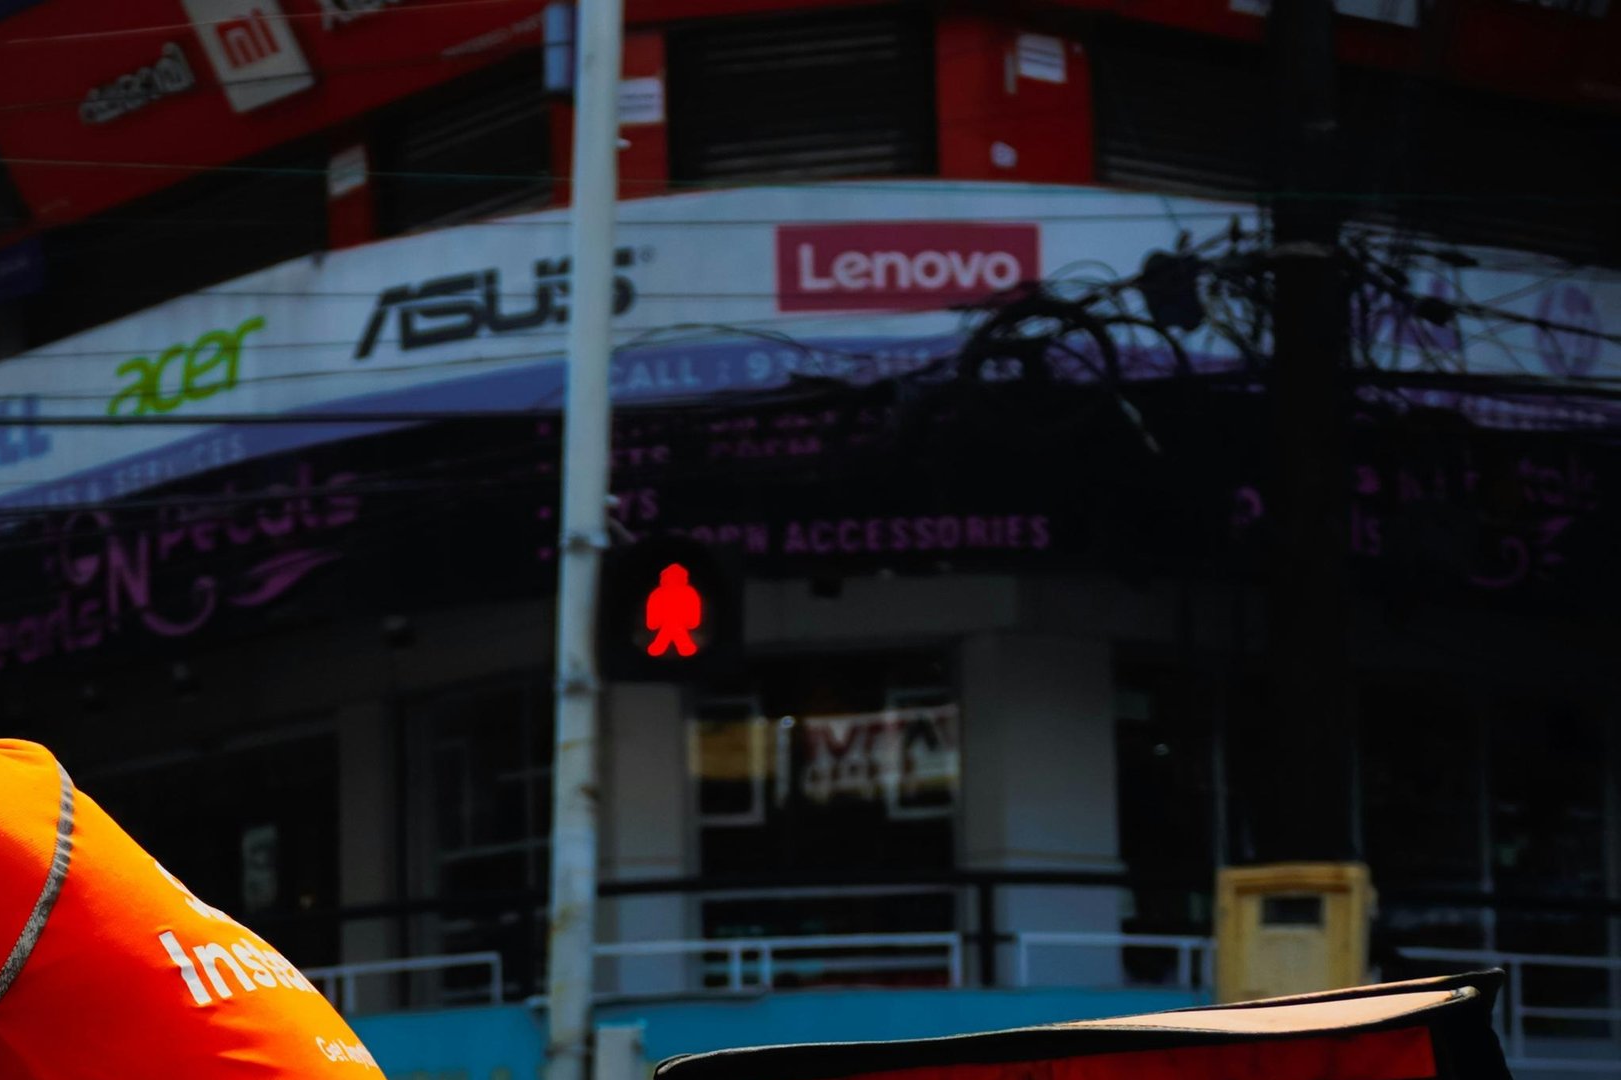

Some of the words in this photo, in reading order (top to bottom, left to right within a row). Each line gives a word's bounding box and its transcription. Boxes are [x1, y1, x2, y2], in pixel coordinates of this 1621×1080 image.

[797, 242, 1022, 291] Lenovo
[109, 318, 265, 417] acer
[783, 514, 1052, 554] ACCESSORIES
